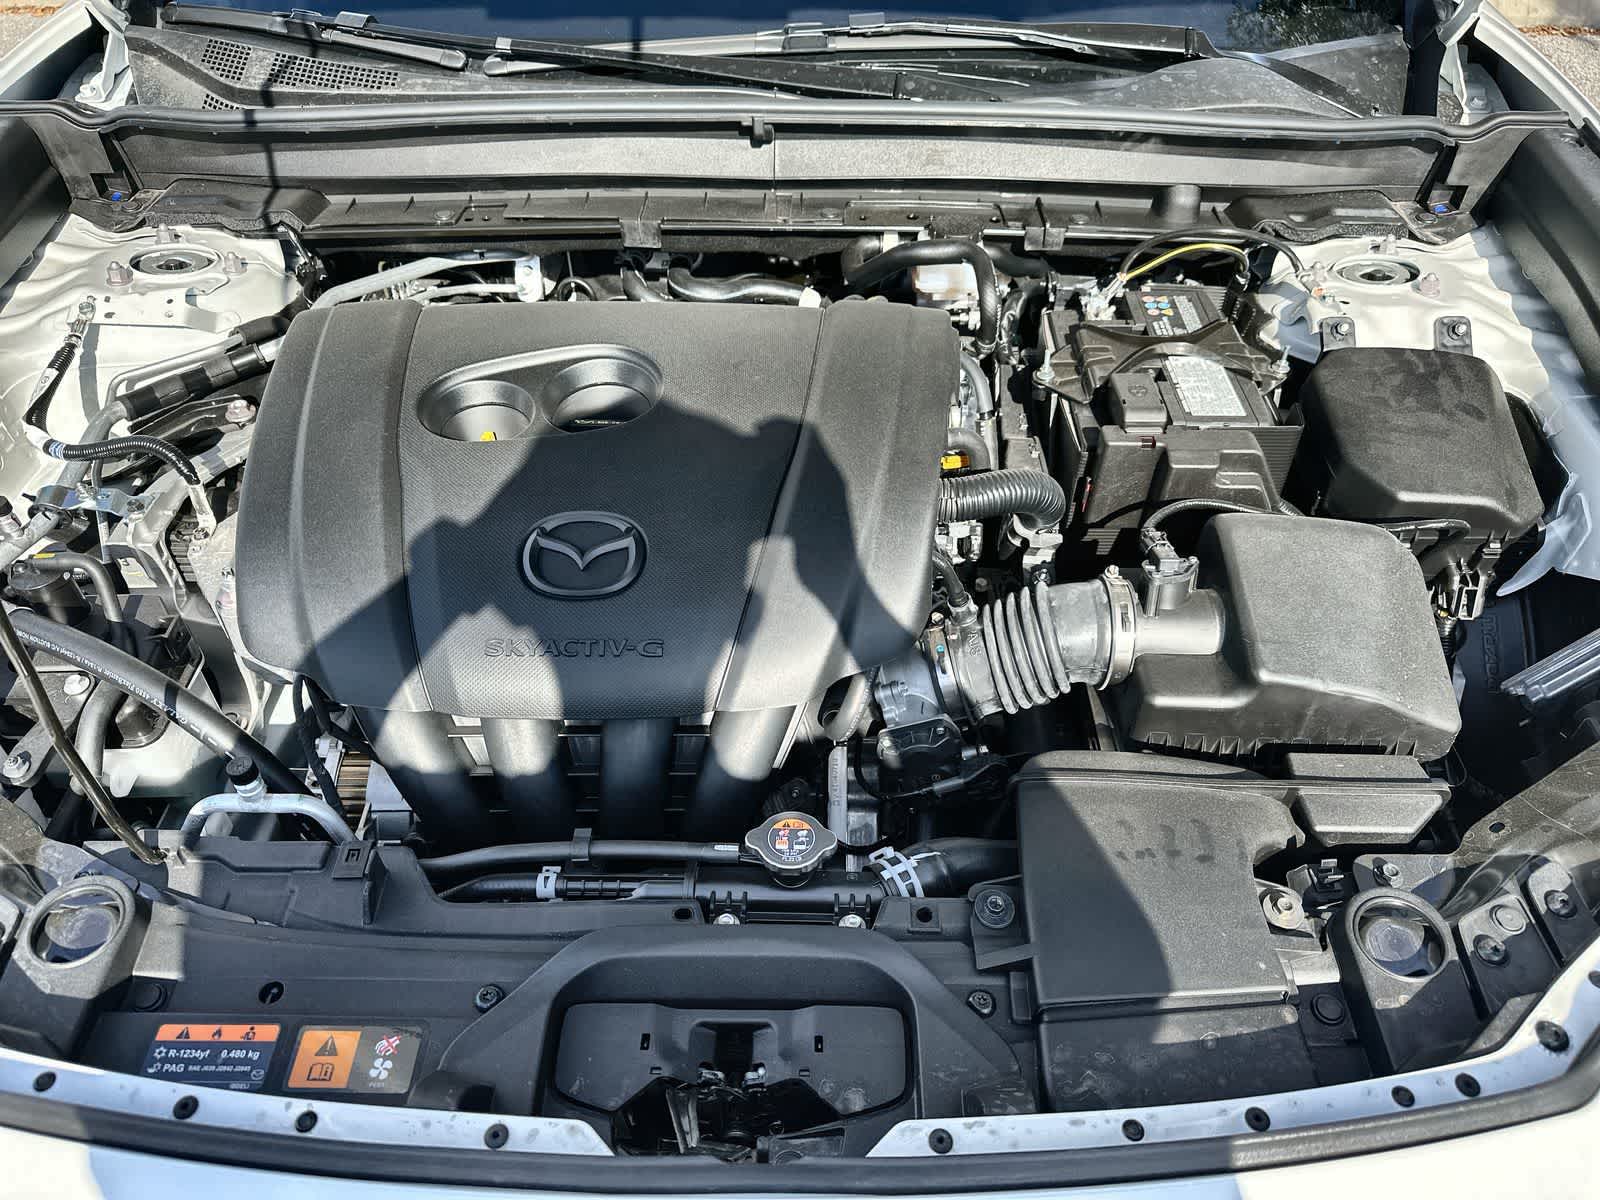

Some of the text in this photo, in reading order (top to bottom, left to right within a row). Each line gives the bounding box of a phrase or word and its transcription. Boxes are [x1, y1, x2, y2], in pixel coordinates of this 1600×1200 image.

[484, 638, 664, 658] SKYACTIV-G
[168, 1049, 260, 1060] R-1234yf 0.480 kg
[162, 1063, 185, 1073] PAG
